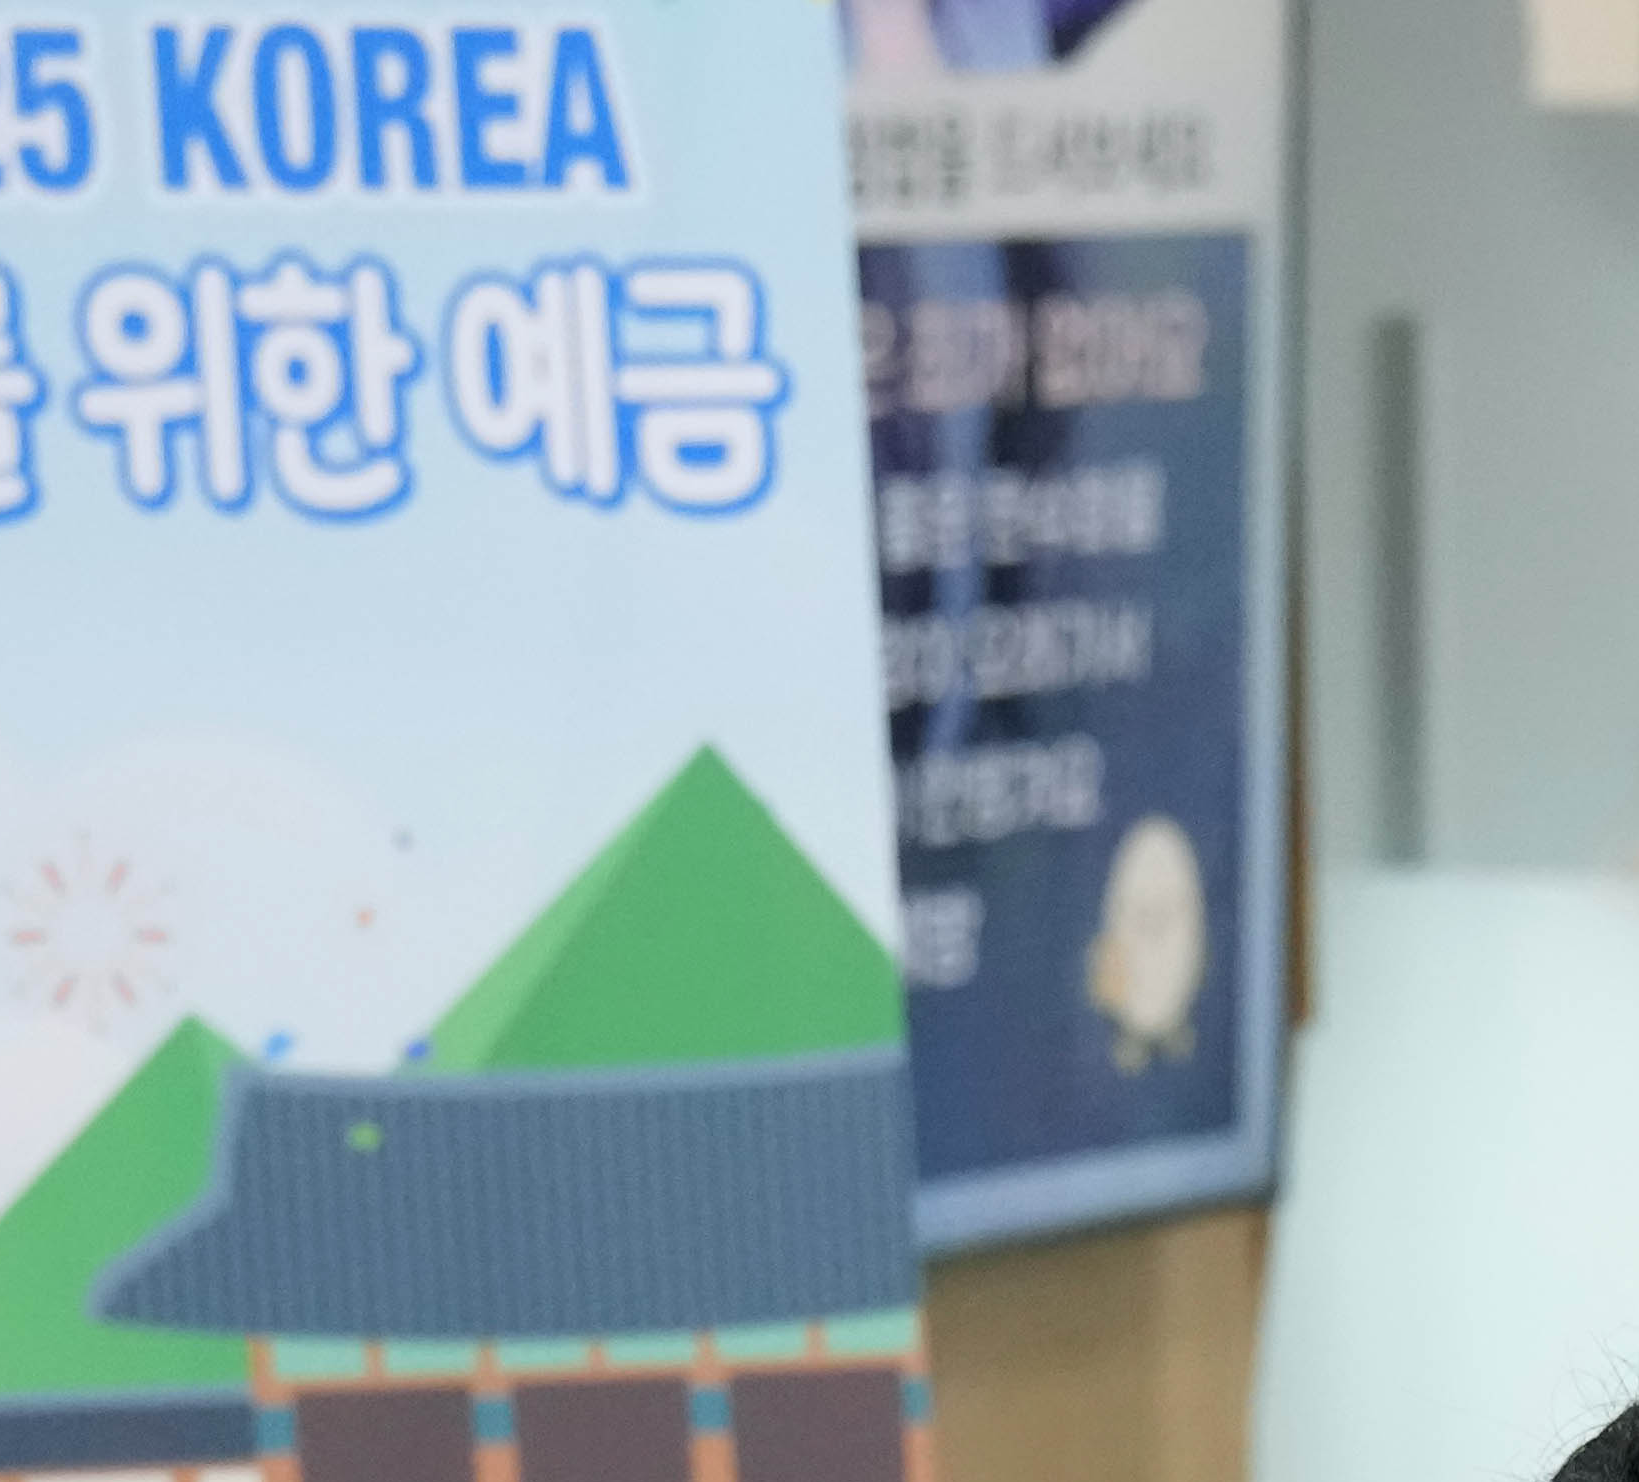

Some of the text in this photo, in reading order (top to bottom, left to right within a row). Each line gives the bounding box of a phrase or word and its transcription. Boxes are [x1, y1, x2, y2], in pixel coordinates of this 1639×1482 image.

[156, 23, 633, 196] KOREA
[73, 247, 425, 519] 위한
[438, 253, 788, 519] 예금
